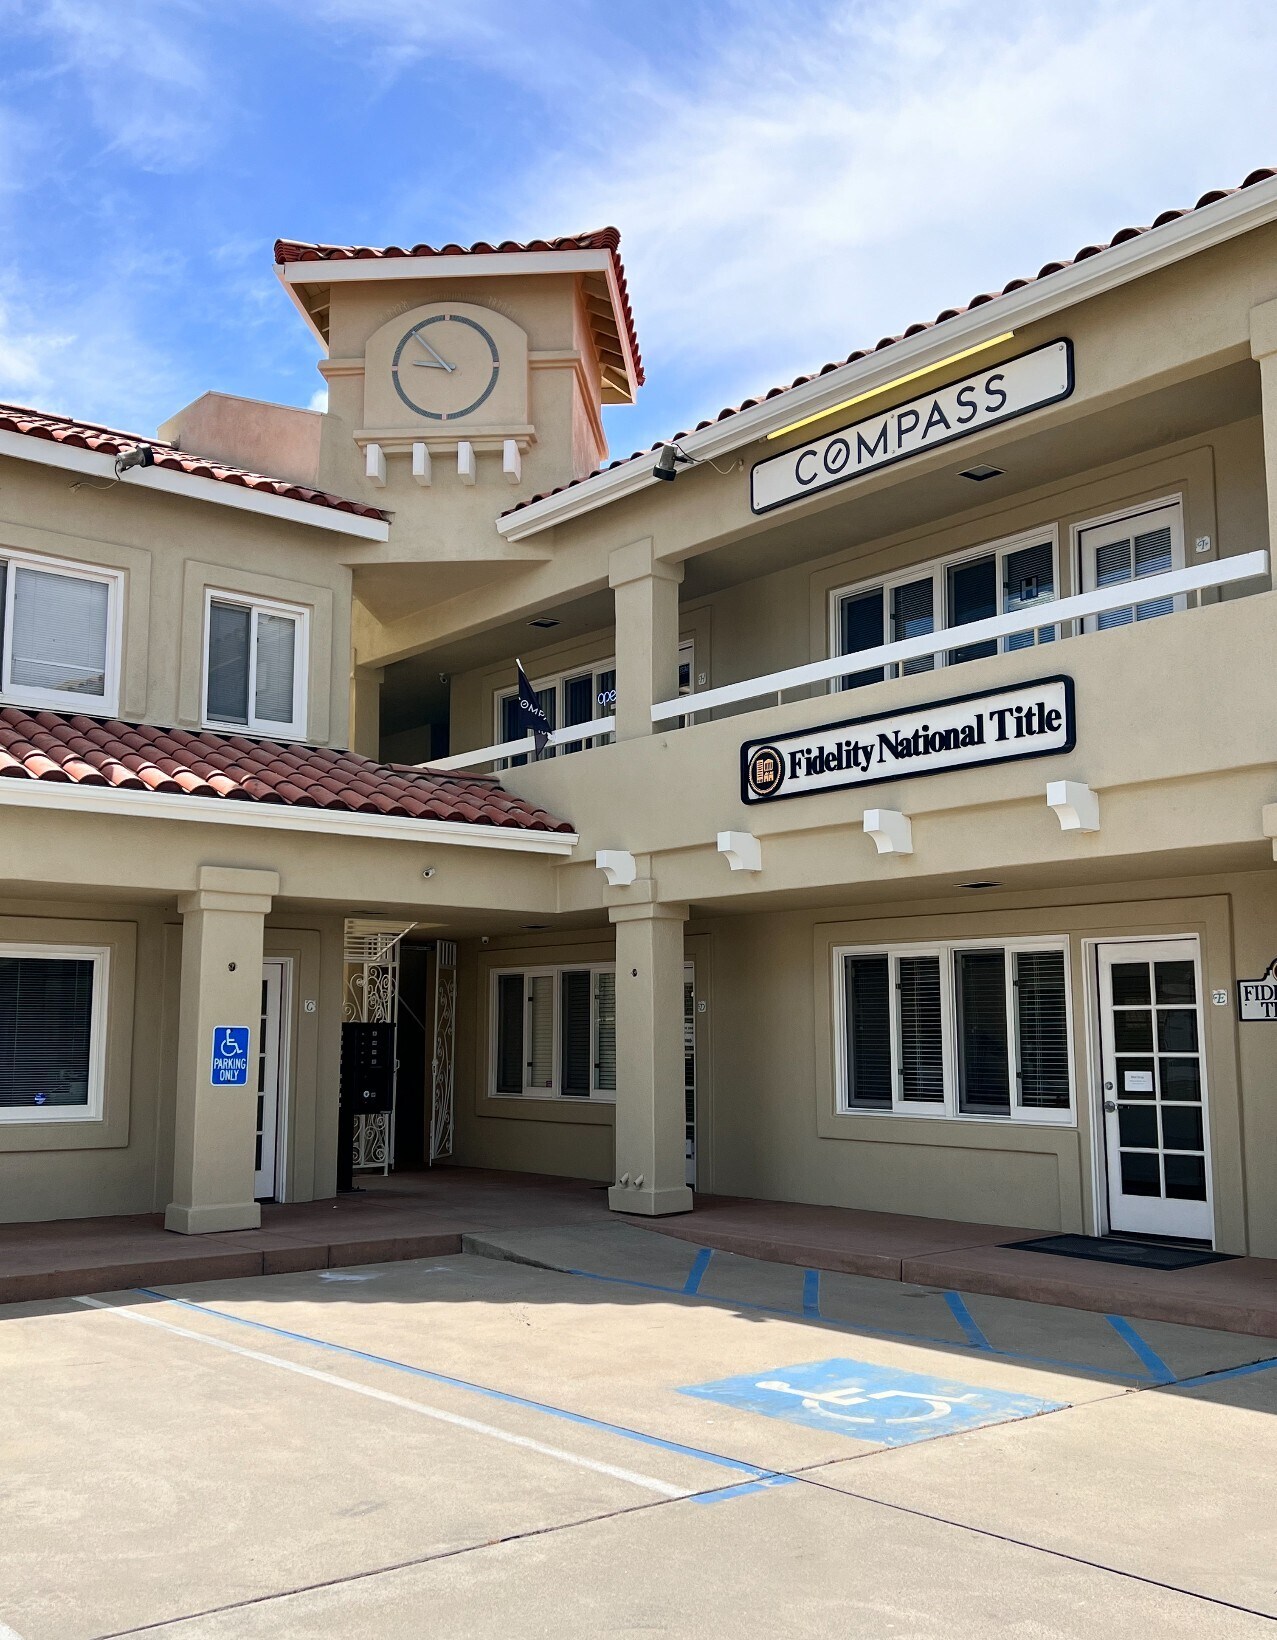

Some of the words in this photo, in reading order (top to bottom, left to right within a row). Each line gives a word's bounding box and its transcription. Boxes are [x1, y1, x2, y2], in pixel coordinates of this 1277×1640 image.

[795, 373, 1007, 485] COMPASS
[518, 696, 547, 720] OMP
[787, 740, 875, 772] Fidelity
[877, 714, 986, 763] National
[989, 702, 1062, 741] Title
[213, 1058, 247, 1070] PARKING
[219, 1069, 240, 1081] ONLY
